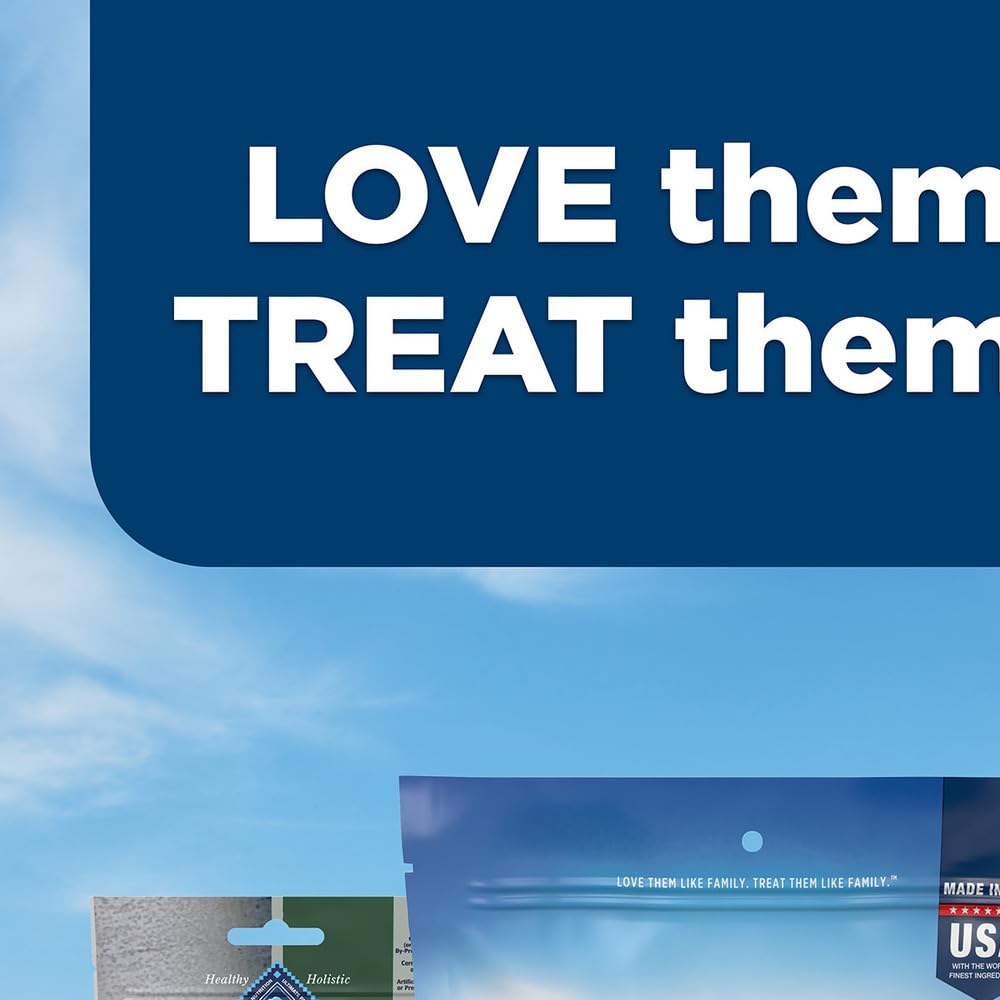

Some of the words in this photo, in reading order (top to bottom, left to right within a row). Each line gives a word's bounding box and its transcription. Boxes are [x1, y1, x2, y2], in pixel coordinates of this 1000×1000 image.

[617, 876, 644, 888] LOVE
[648, 877, 676, 888] THEM
[680, 878, 703, 889] LIKE
[707, 877, 749, 888] FAMILY.
[752, 877, 785, 889] TREAT
[790, 877, 817, 888] THEM
[821, 877, 844, 888] LIKE
[944, 882, 984, 895] MADE
[204, 974, 249, 986] Healthy
[306, 974, 350, 985] Holistic
